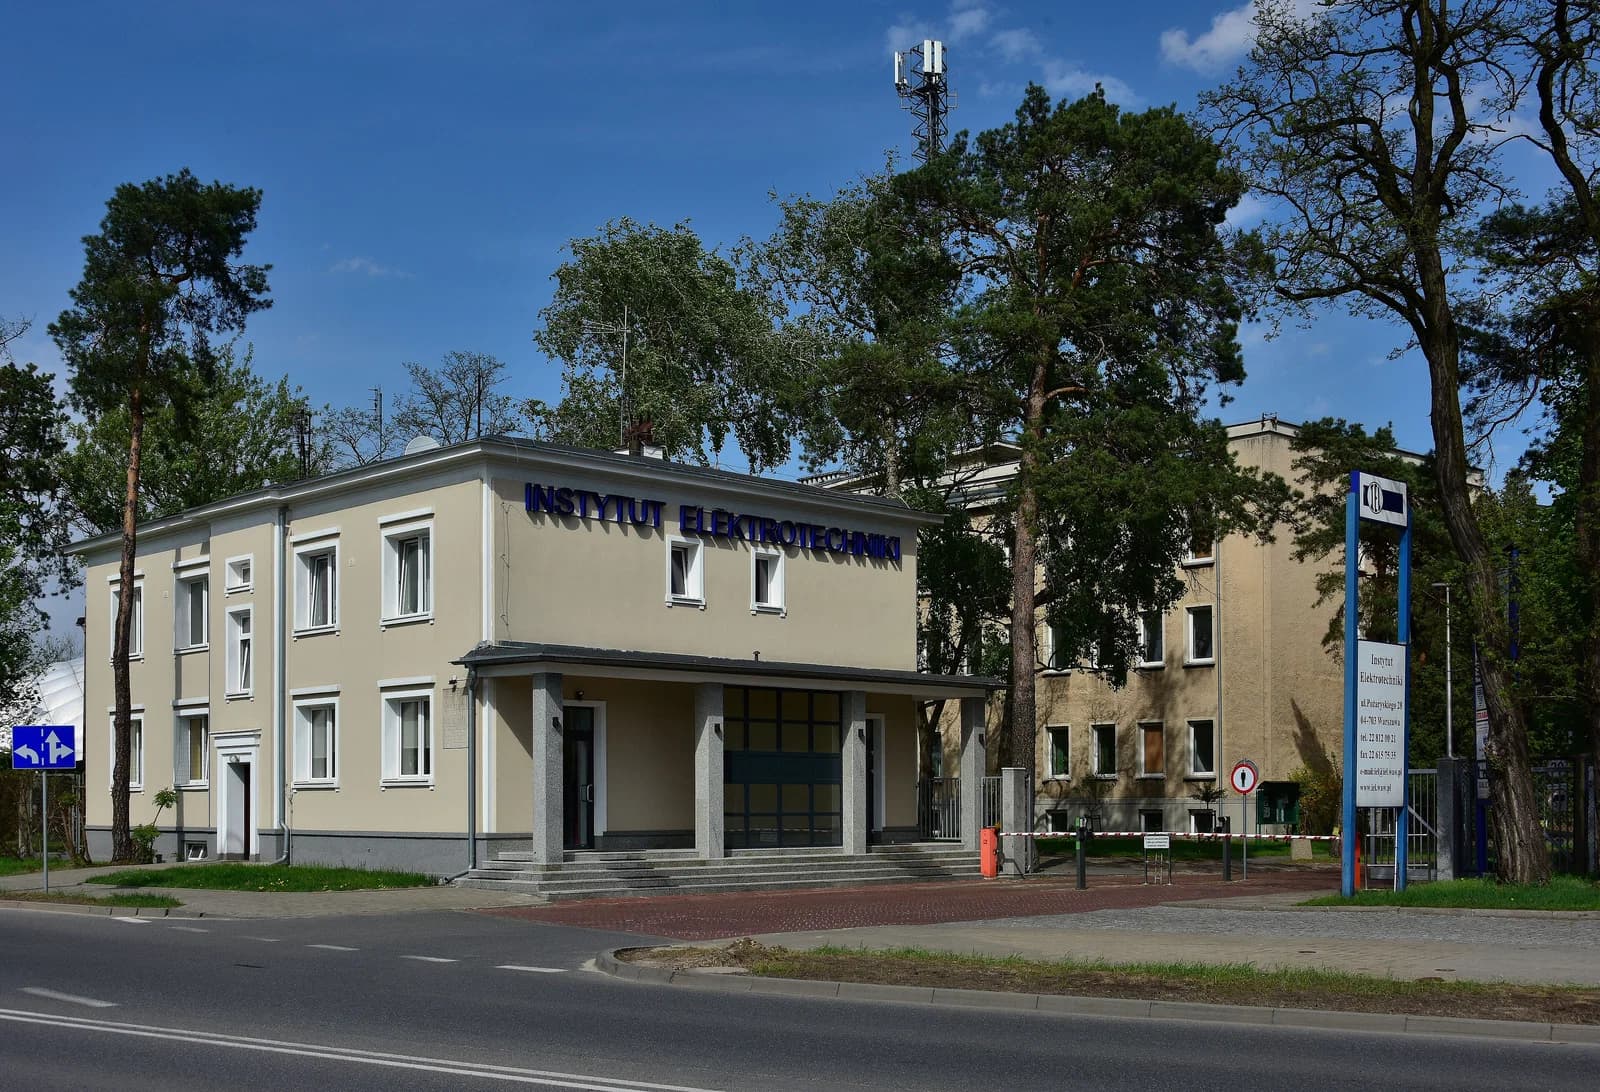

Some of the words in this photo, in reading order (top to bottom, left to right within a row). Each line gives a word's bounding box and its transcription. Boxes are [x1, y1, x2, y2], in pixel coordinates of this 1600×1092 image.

[525, 482, 667, 528] INSTYTUT
[680, 504, 900, 561] ELEKTROTECHNIKI
[1371, 653, 1393, 669] Instytut
[1360, 671, 1403, 686] Elektrotechniki
